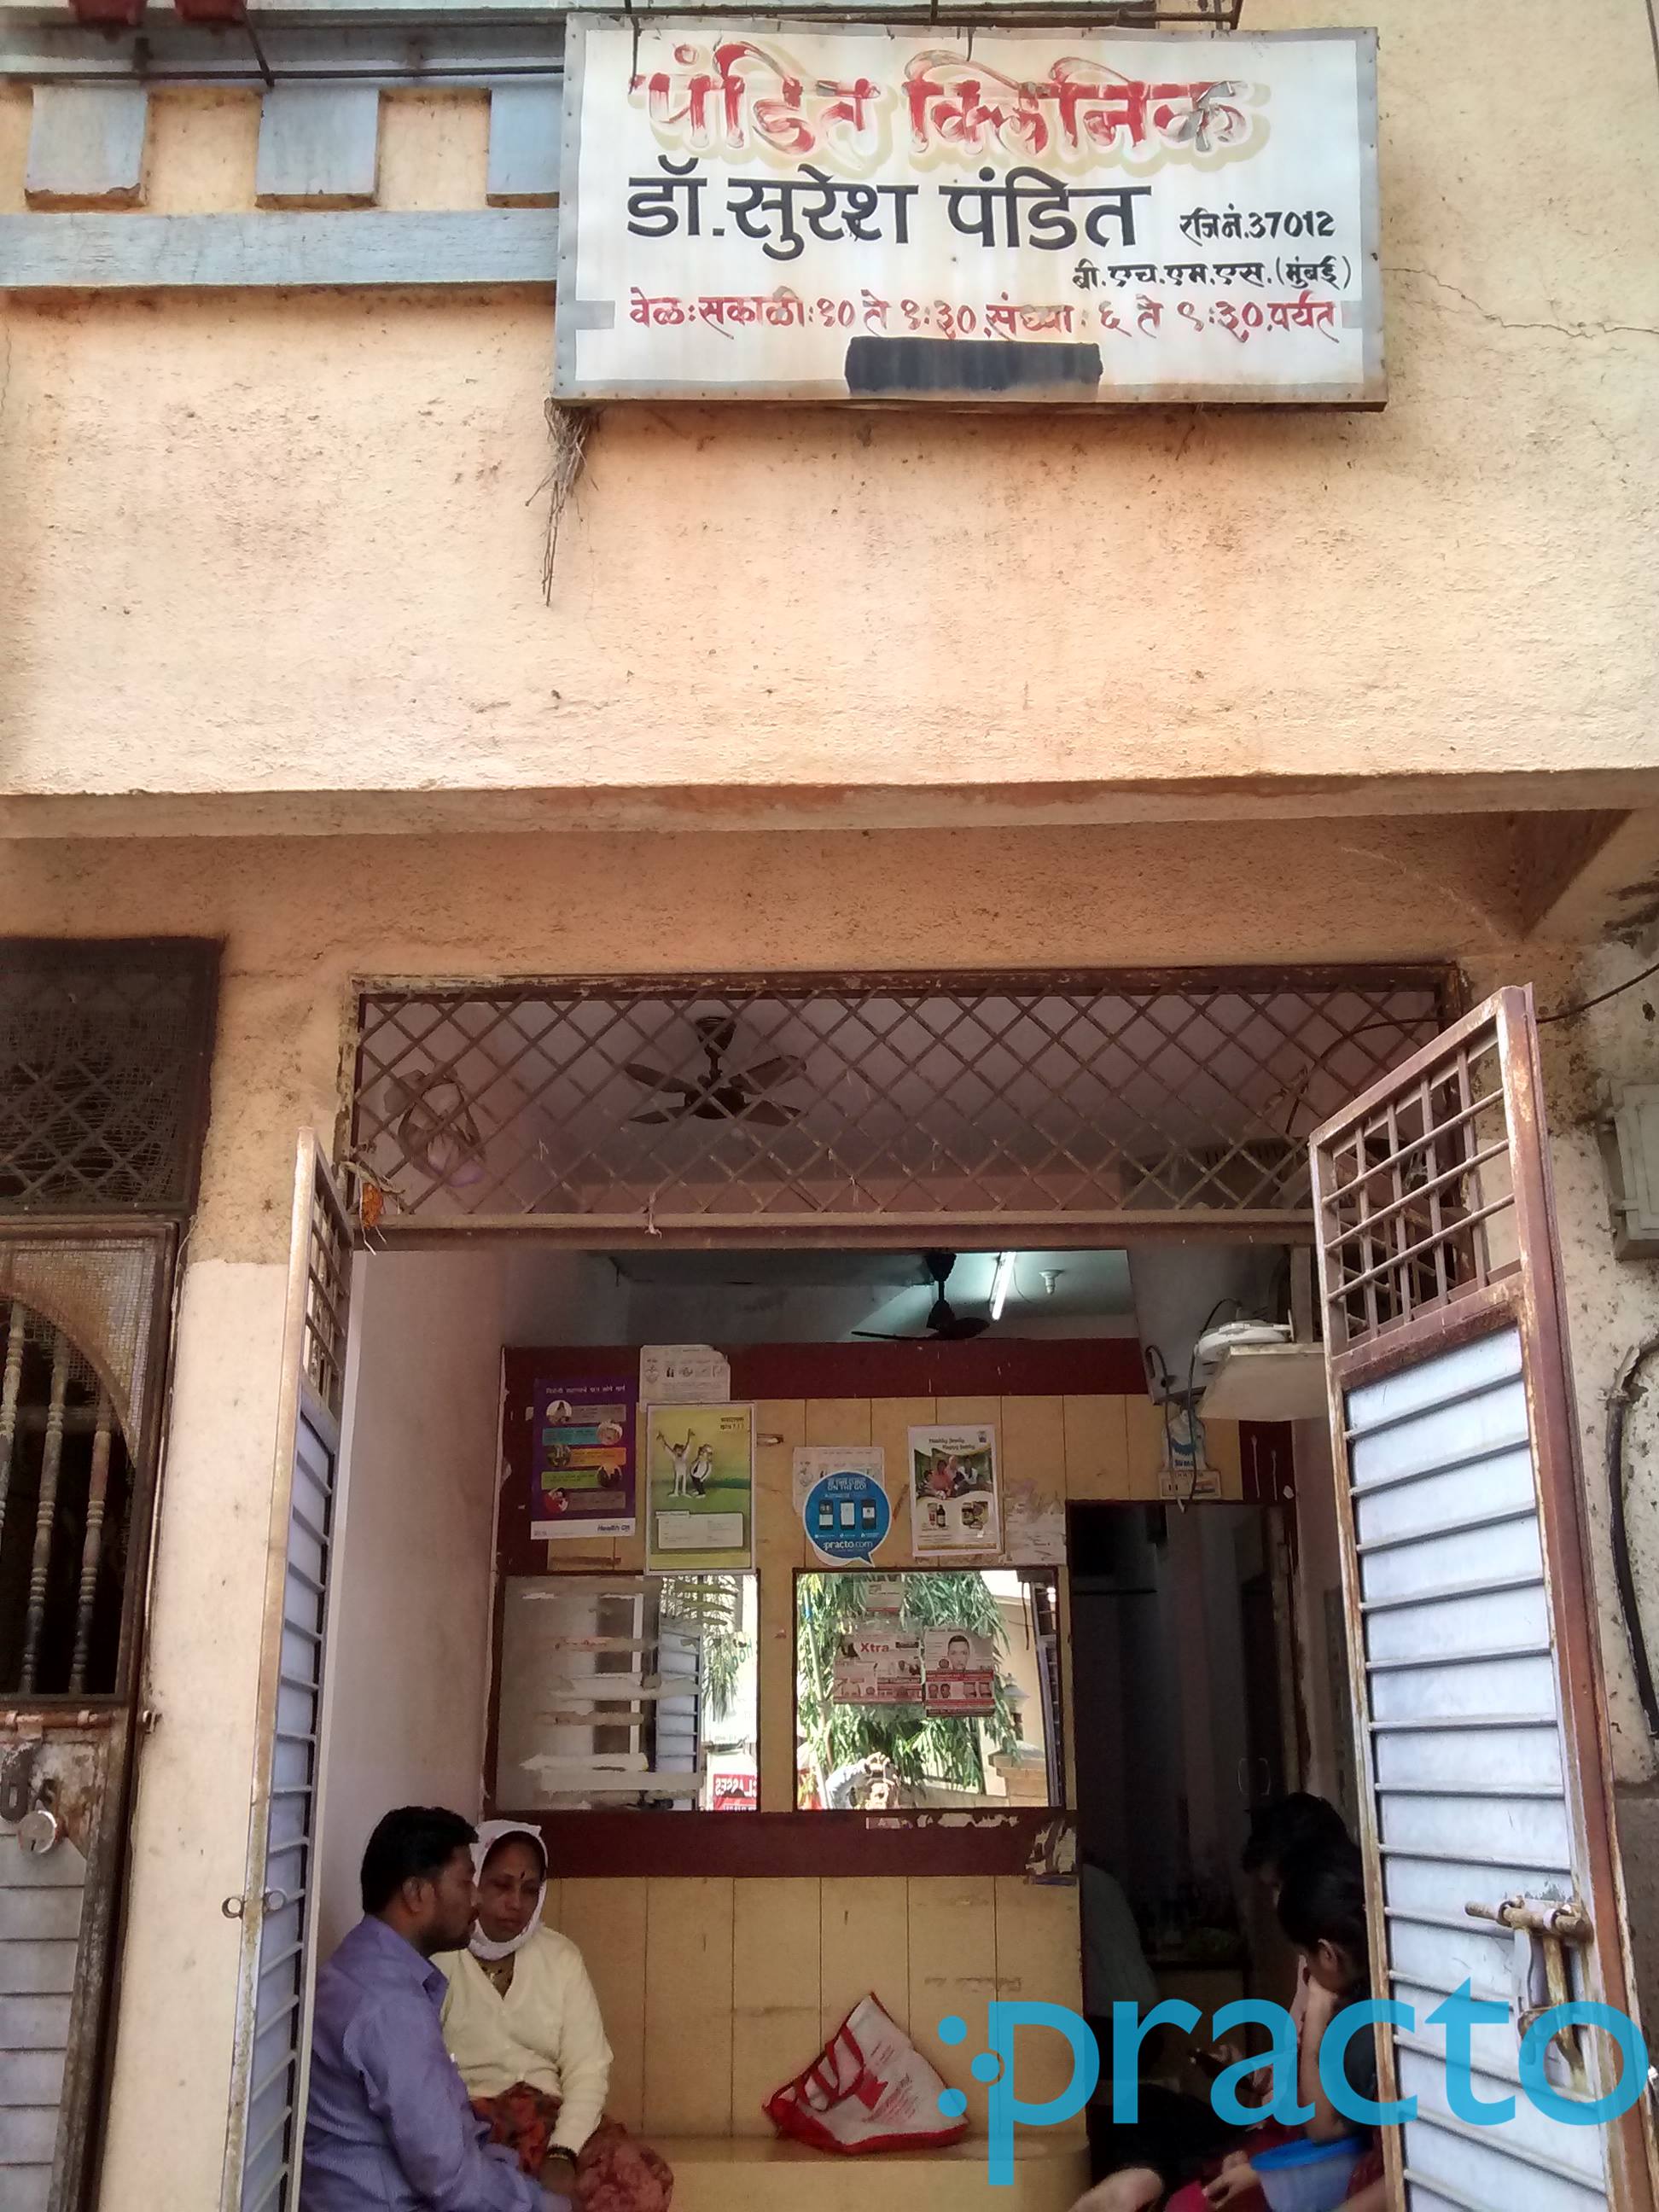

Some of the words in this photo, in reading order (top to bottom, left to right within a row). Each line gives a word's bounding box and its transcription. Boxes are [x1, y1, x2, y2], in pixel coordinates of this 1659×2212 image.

[939, 166, 1152, 250] पंडित
[860, 288, 892, 336] ते
[1136, 293, 1164, 340] ते
[860, 1642, 889, 1653] Xtra
